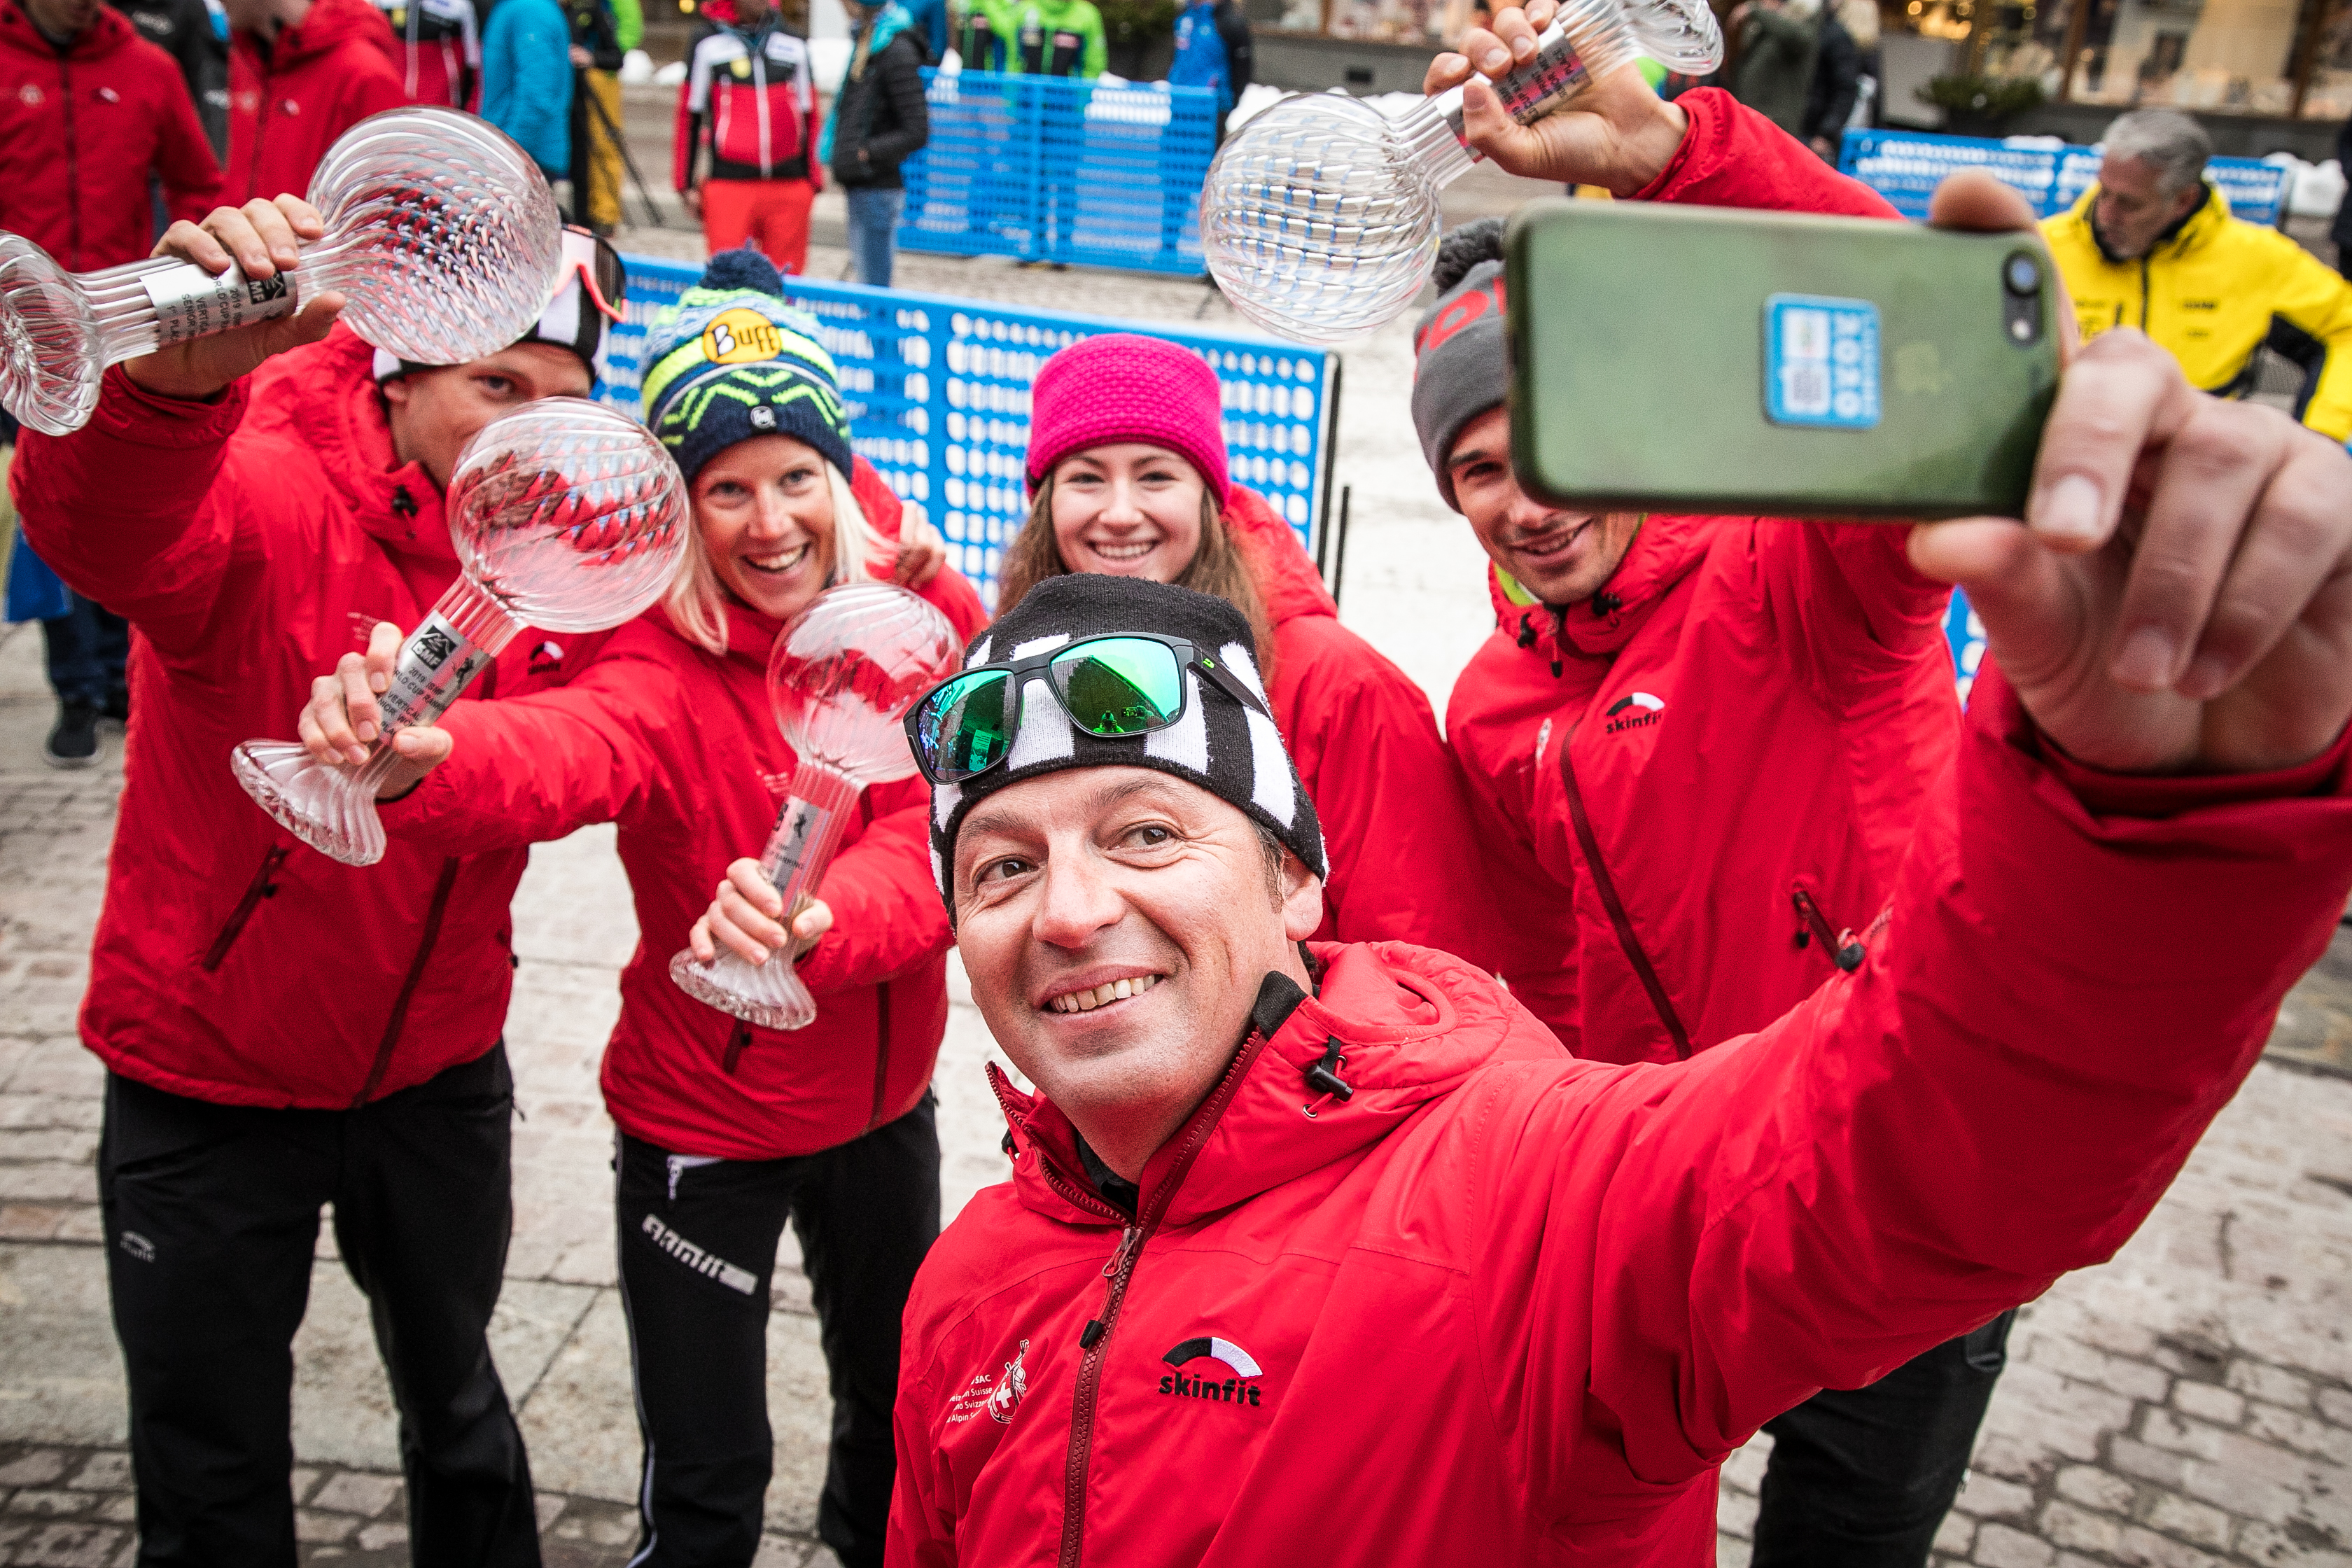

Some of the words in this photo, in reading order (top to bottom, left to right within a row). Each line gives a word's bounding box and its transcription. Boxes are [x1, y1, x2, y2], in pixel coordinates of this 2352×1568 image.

[181, 293, 197, 328] SENIOR
[230, 288, 241, 309] 2019
[195, 297, 209, 334] VERTICA
[218, 302, 230, 325] CUP
[412, 641, 441, 667] ISMF
[407, 682, 424, 696] CUP
[408, 667, 427, 683] 2019
[426, 681, 444, 696] ISMF
[388, 691, 421, 721] VERTICAL
[970, 1387, 993, 1396] Suisse
[974, 1374, 992, 1385] SAC
[1158, 1372, 1261, 1406] skinfit
[951, 1413, 969, 1423] Alpin
